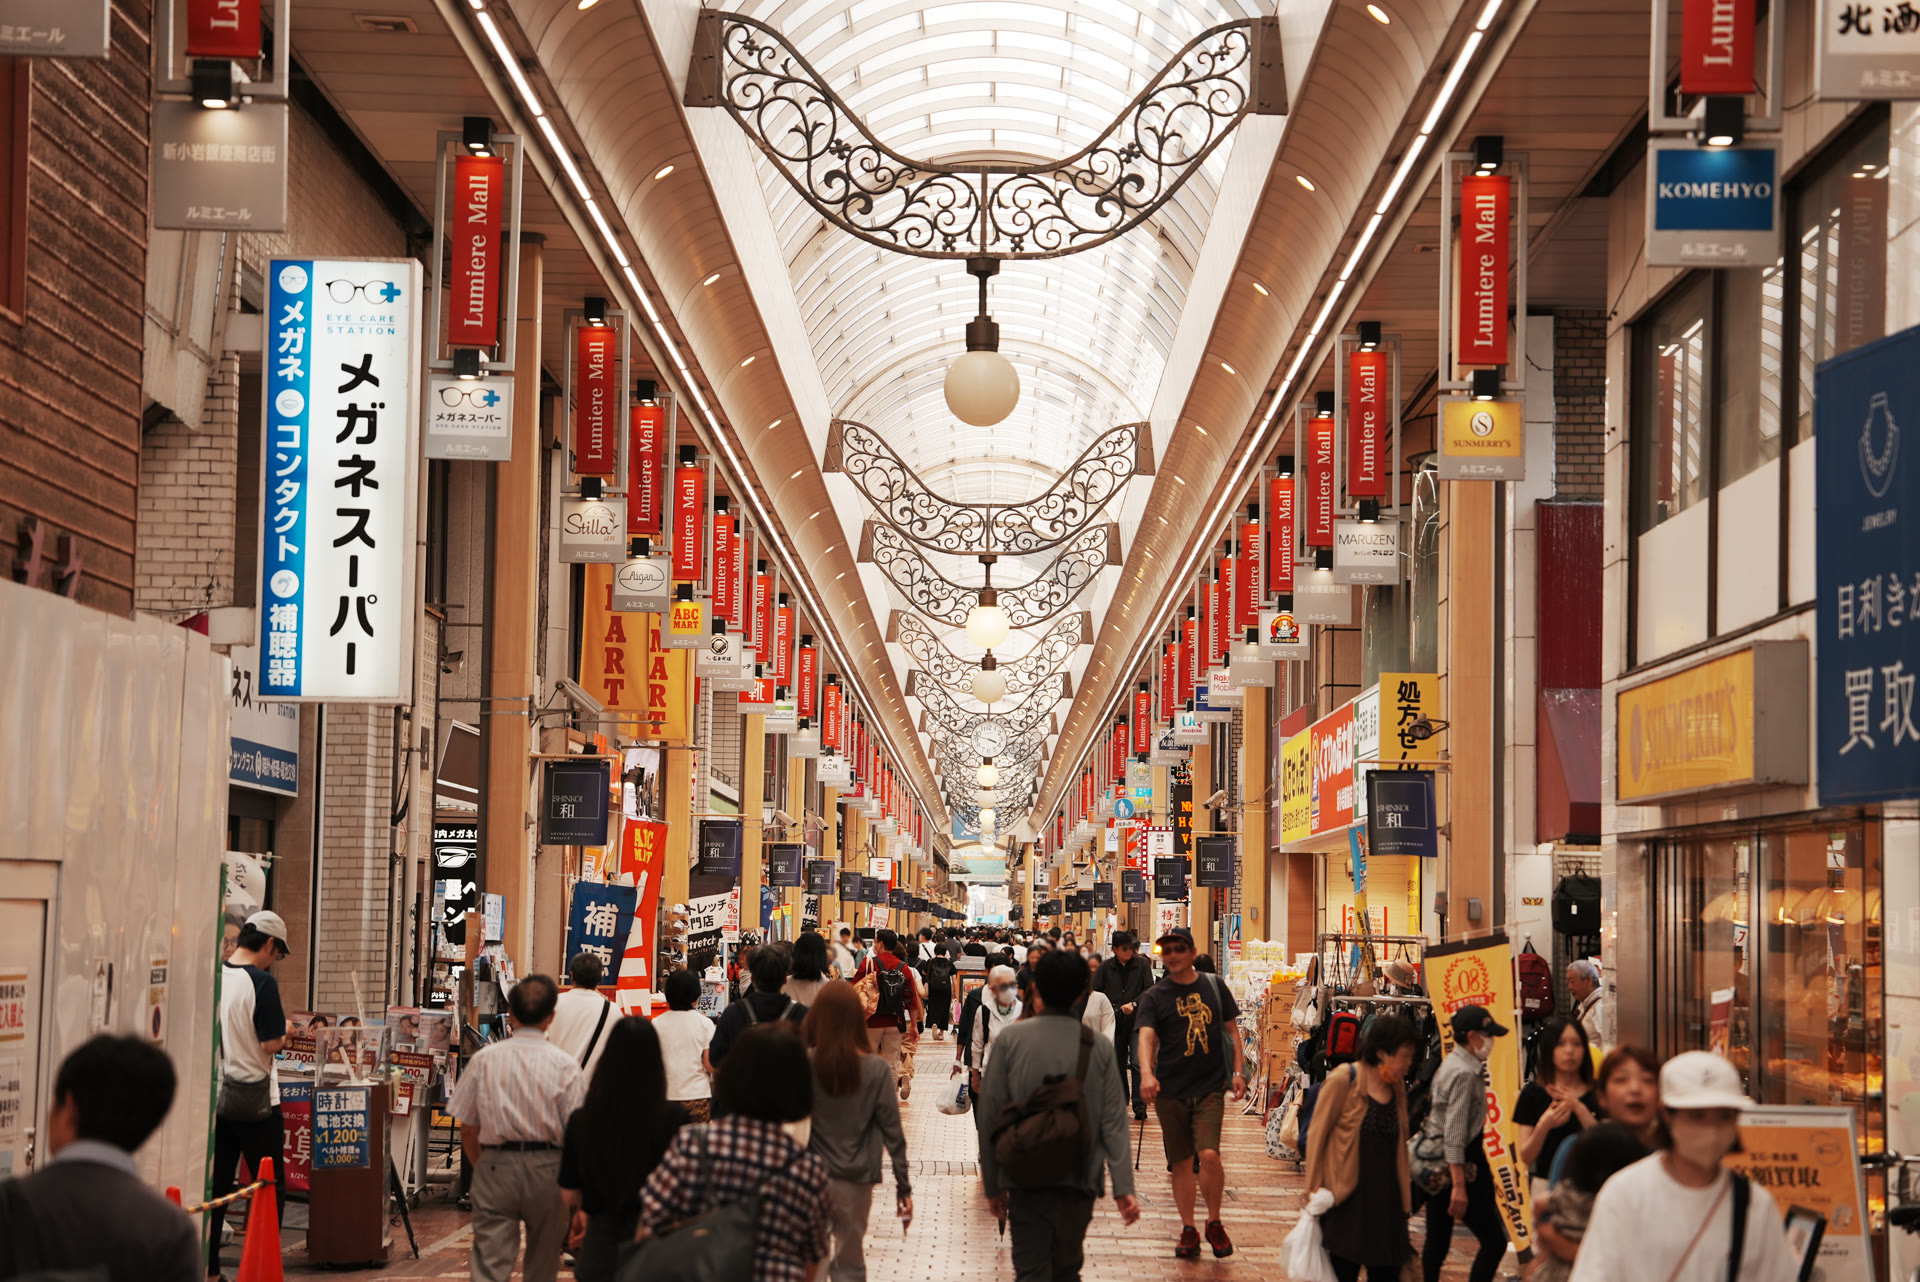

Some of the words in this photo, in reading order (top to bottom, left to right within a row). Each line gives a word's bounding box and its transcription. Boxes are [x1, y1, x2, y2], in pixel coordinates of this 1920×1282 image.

[163, 142, 276, 163] 新小岩銀座商店街
[468, 175, 489, 225] Mall
[1659, 182, 1771, 199] KOMEHYO
[186, 206, 251, 221] ルミエール
[1476, 194, 1496, 244] Mall
[1681, 243, 1747, 256] ルミエール
[464, 234, 487, 328] Lumiere
[1474, 255, 1494, 348] Lumiere
[326, 314, 351, 322] EYE
[360, 314, 396, 324] CARE
[326, 326, 396, 335] STATION
[276, 301, 305, 382] メガネ
[588, 342, 605, 380] Mall
[1361, 365, 1376, 403] Mall
[436, 412, 502, 423] メガネスーパー
[588, 388, 604, 460] Lumiere
[640, 419, 654, 453] Mall
[1318, 430, 1332, 464] Mall
[1360, 411, 1376, 482] Lumiere
[1453, 440, 1511, 448] SUNMERRY'S
[446, 445, 489, 454] ルミエール
[1460, 464, 1503, 474] ルミエール
[273, 425, 302, 562] コンタクト
[638, 459, 652, 523] Lumiere
[683, 479, 695, 509] Mall
[1317, 471, 1331, 534] Lumiere
[330, 354, 386, 675] メガネスーパー
[1280, 490, 1292, 520] Mall
[564, 513, 612, 535] Stilla
[682, 514, 694, 570] Lumiere
[716, 525, 728, 552] Mall
[1249, 534, 1260, 560] Mall
[1338, 534, 1395, 546] MARUZEN
[1279, 525, 1291, 582] Lumiere
[630, 571, 654, 584] Aigan
[715, 557, 726, 607] Lumiere
[1248, 566, 1259, 617] Lumiere
[674, 608, 699, 620] ABC
[674, 620, 699, 628] MART
[778, 615, 786, 636] Mall
[268, 604, 298, 687] 補聴器
[778, 639, 786, 679] Lumiere
[804, 654, 812, 673] Mall
[802, 676, 811, 710] Lumiere
[1838, 662, 1920, 756] 買取
[560, 803, 574, 818] 和
[1386, 812, 1402, 827] 和
[709, 848, 720, 858] 和
[1206, 862, 1215, 872] 和
[688, 914, 714, 930] 門店
[318, 1092, 349, 1110] 時計
[316, 1114, 365, 1128] 電池交換
[316, 1129, 358, 1144] ¥1,200
[324, 1154, 352, 1164] ¥3,000
